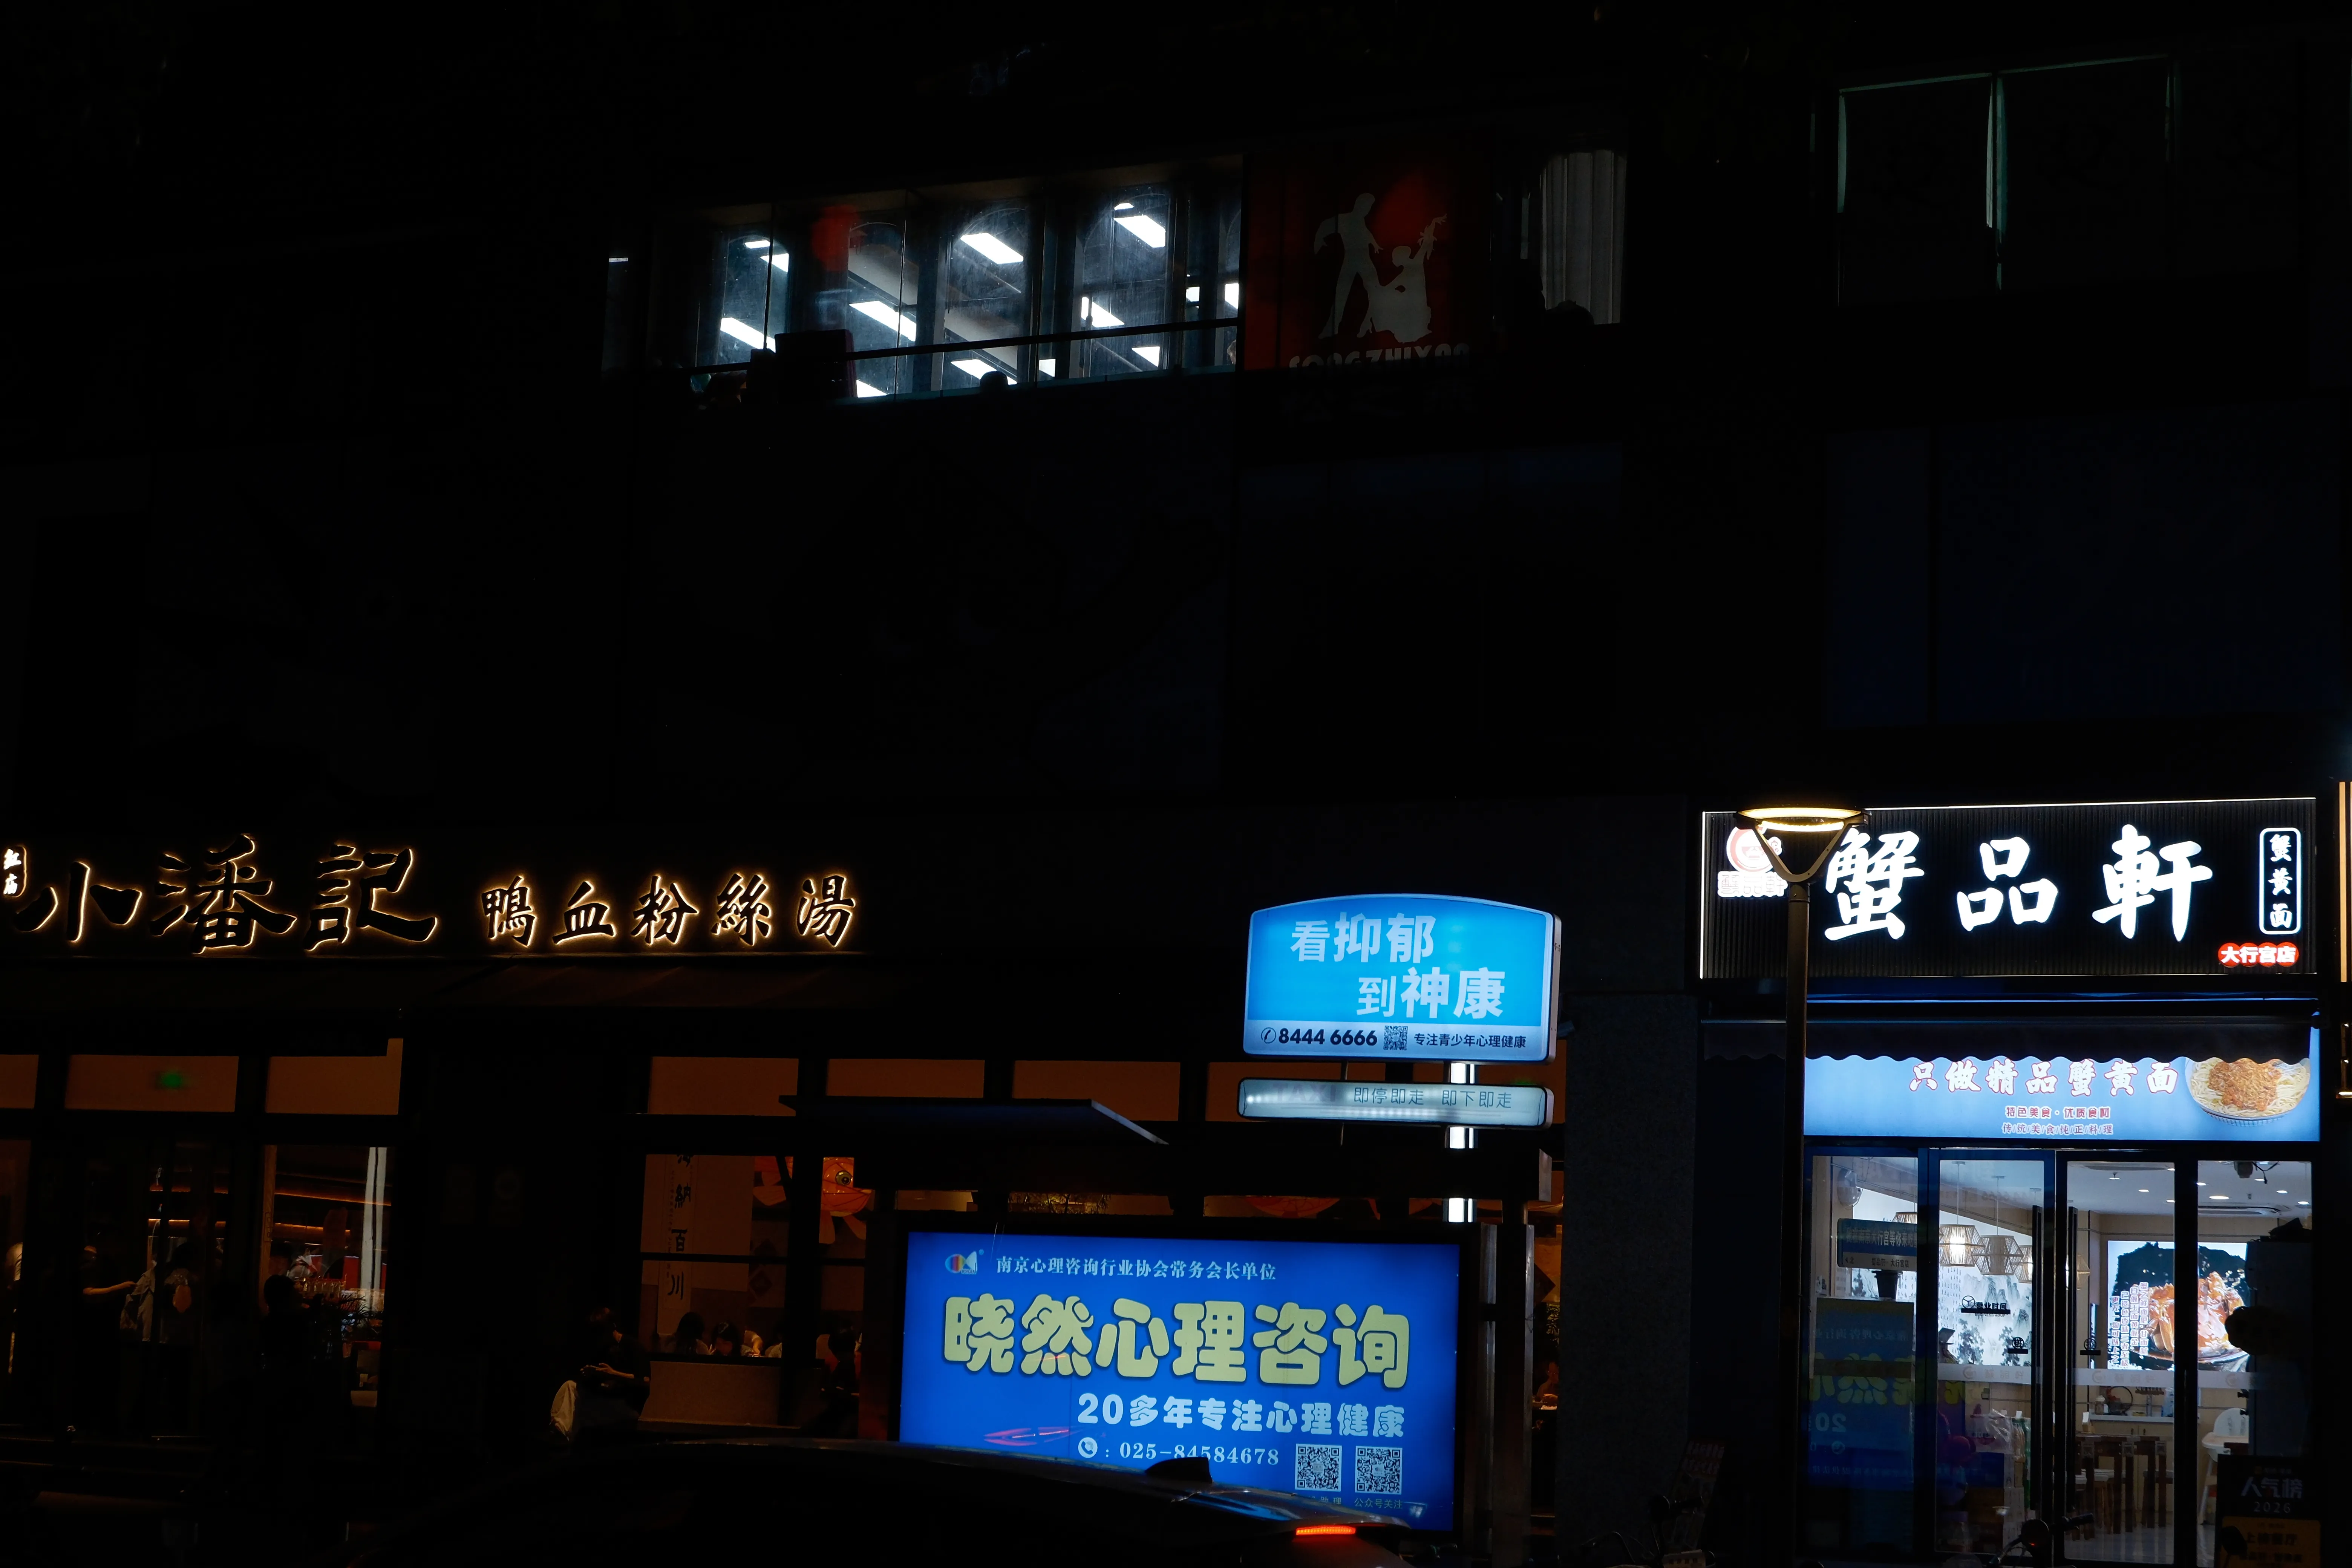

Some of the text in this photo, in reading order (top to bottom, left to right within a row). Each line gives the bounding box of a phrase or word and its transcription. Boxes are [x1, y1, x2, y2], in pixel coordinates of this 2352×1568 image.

[481, 875, 856, 946] 鴨血粉絲湯
[1291, 912, 1436, 963] 看抑郁
[2221, 945, 2296, 963] 大行宫店
[1357, 967, 1505, 1019] 到神康
[1278, 1028, 1378, 1046] 8444 6666
[1414, 1033, 1527, 1049] 专注青少年心理健康
[1909, 1058, 2178, 1096] 只做精品蟹黄面
[1354, 1087, 1512, 1109] 即停即走 即下即走
[997, 1256, 1276, 1280] 南京心理咨询行业协会常务会长单位
[944, 1293, 1410, 1388] 晓然心理咨询
[1077, 1392, 1405, 1439] 20多年专注心理健康
[1354, 1498, 1403, 1509] 公众号关注
